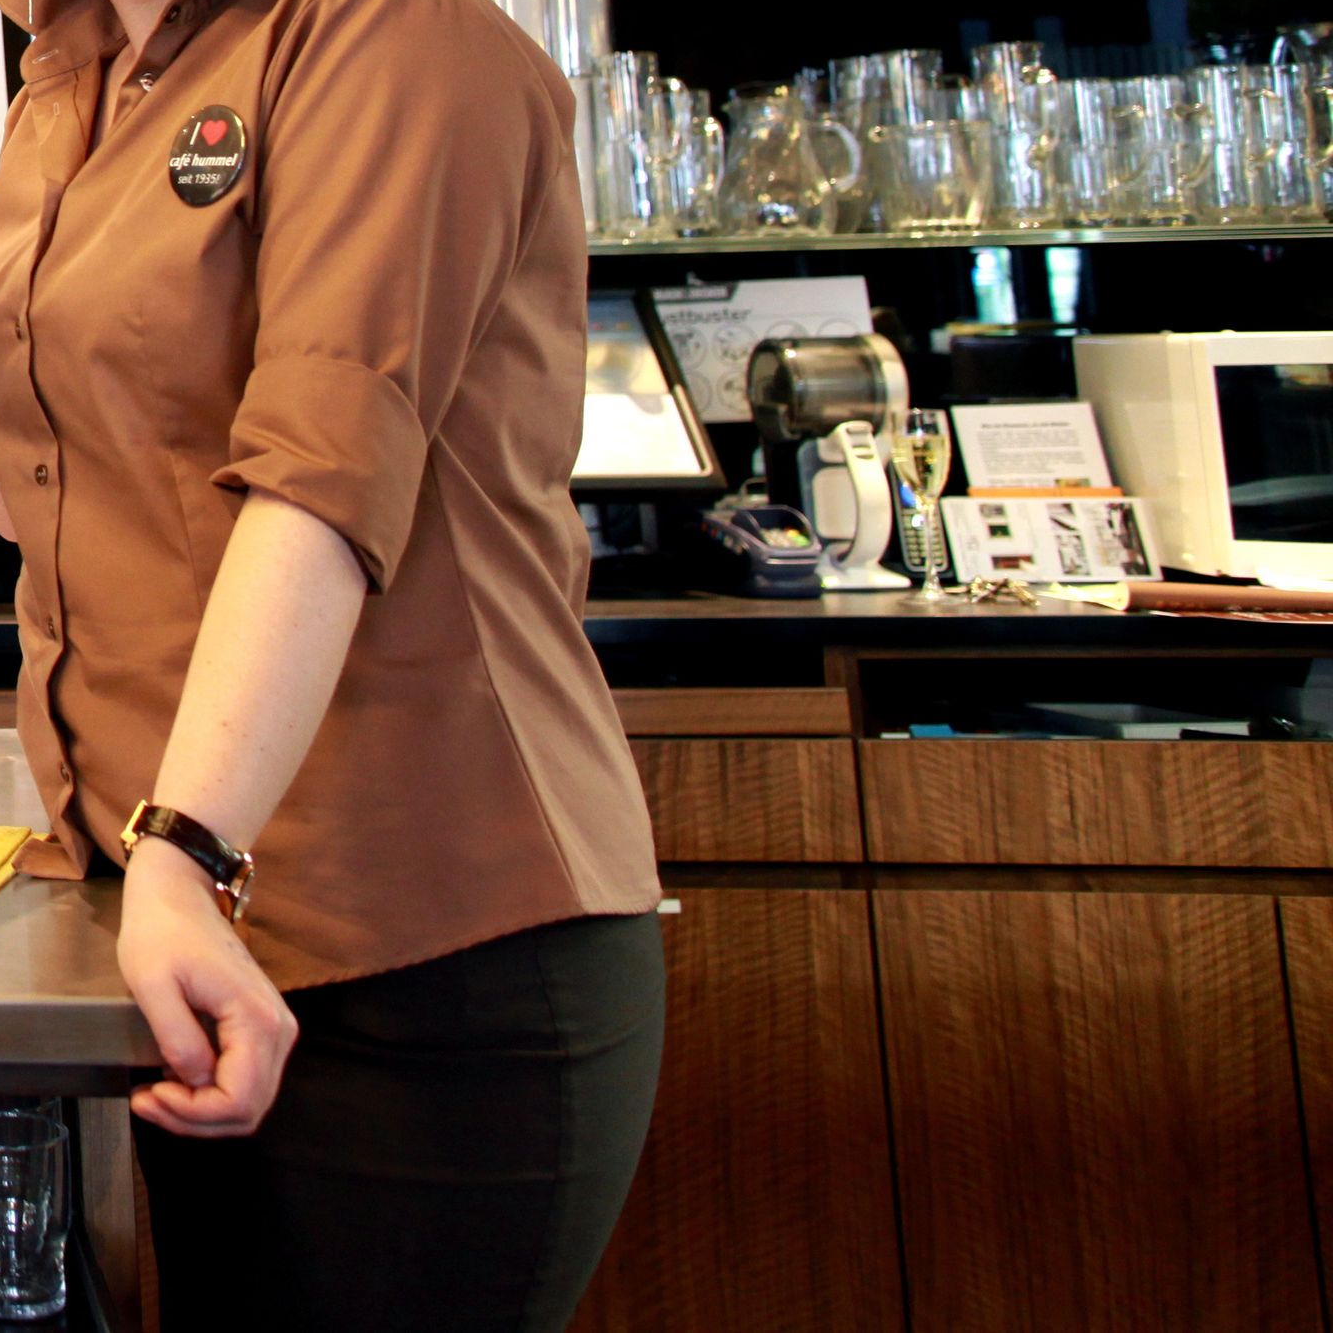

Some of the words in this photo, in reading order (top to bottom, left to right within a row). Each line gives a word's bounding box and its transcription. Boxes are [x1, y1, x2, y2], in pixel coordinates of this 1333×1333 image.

[189, 121, 201, 145] I
[169, 153, 192, 170] café
[191, 153, 238, 167] hummel
[178, 175, 193, 184] seit
